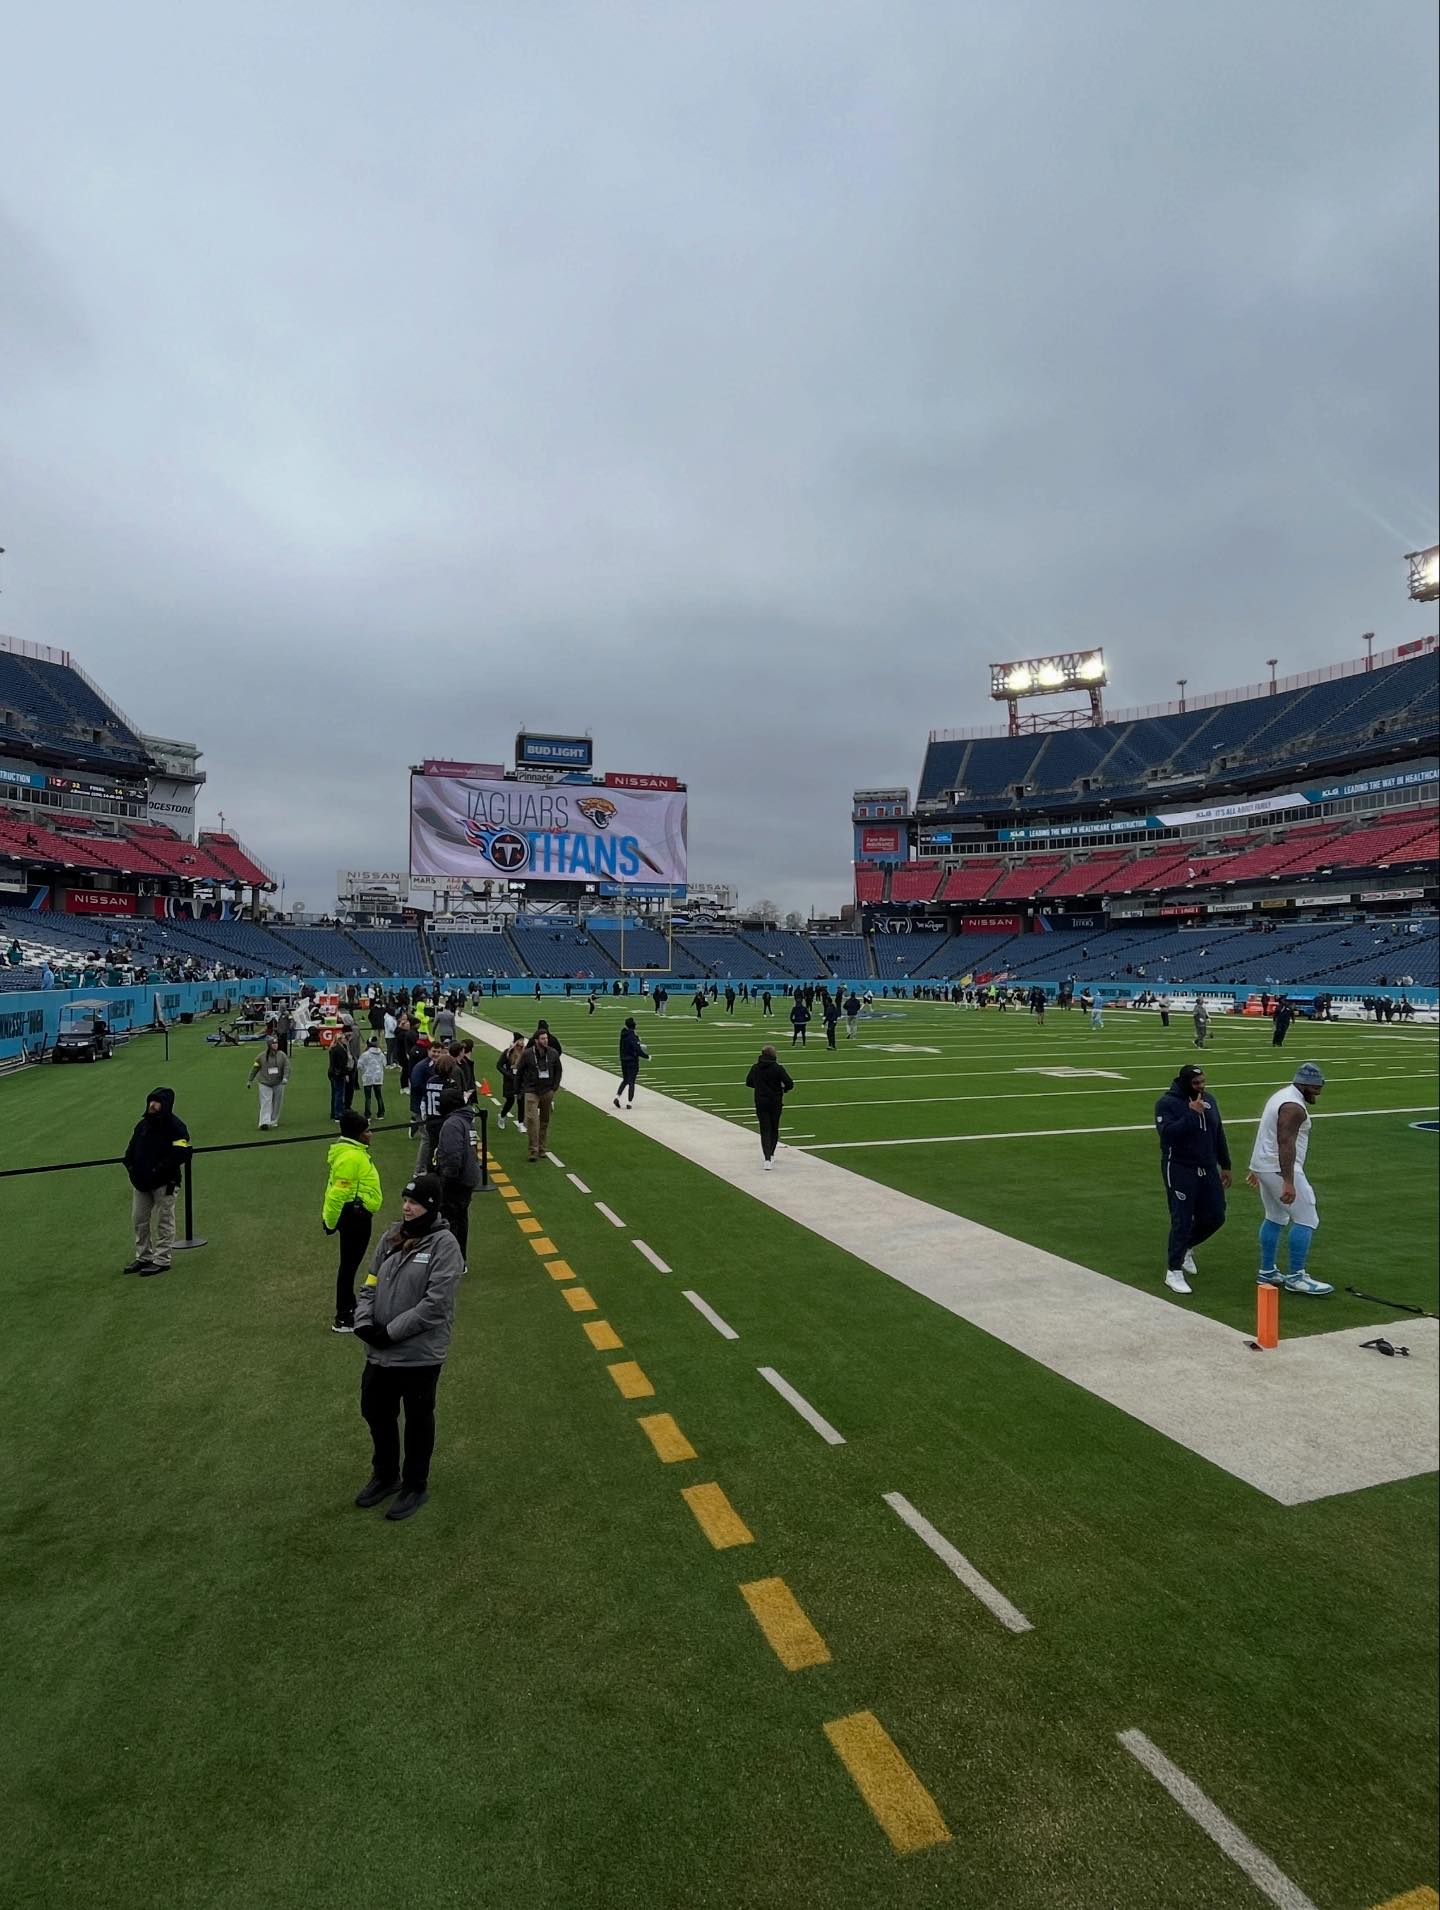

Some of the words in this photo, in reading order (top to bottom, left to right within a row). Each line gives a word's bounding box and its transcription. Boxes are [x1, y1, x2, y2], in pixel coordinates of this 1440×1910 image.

[527, 745, 552, 755] BUD
[553, 747, 585, 758] LIGHT
[518, 771, 554, 782] Pinnacle
[615, 776, 668, 788] NISSAN
[1344, 783, 1368, 795] LEADING
[1369, 781, 1380, 790] THE
[1382, 779, 1395, 788] WAY
[1397, 776, 1404, 785] IN
[1030, 829, 1050, 837] LEADING
[1051, 828, 1060, 836] THE
[1061, 827, 1071, 835] WAY
[1079, 823, 1110, 833] HEALTHCARE
[1111, 819, 1147, 830] CONSTRUCTION
[527, 831, 640, 876] TITANS
[347, 871, 400, 880] NISSAN
[414, 877, 436, 885] MARS
[688, 883, 729, 891] NISSAN
[74, 894, 128, 906] NISSAN
[969, 918, 1013, 926] NISSAN
